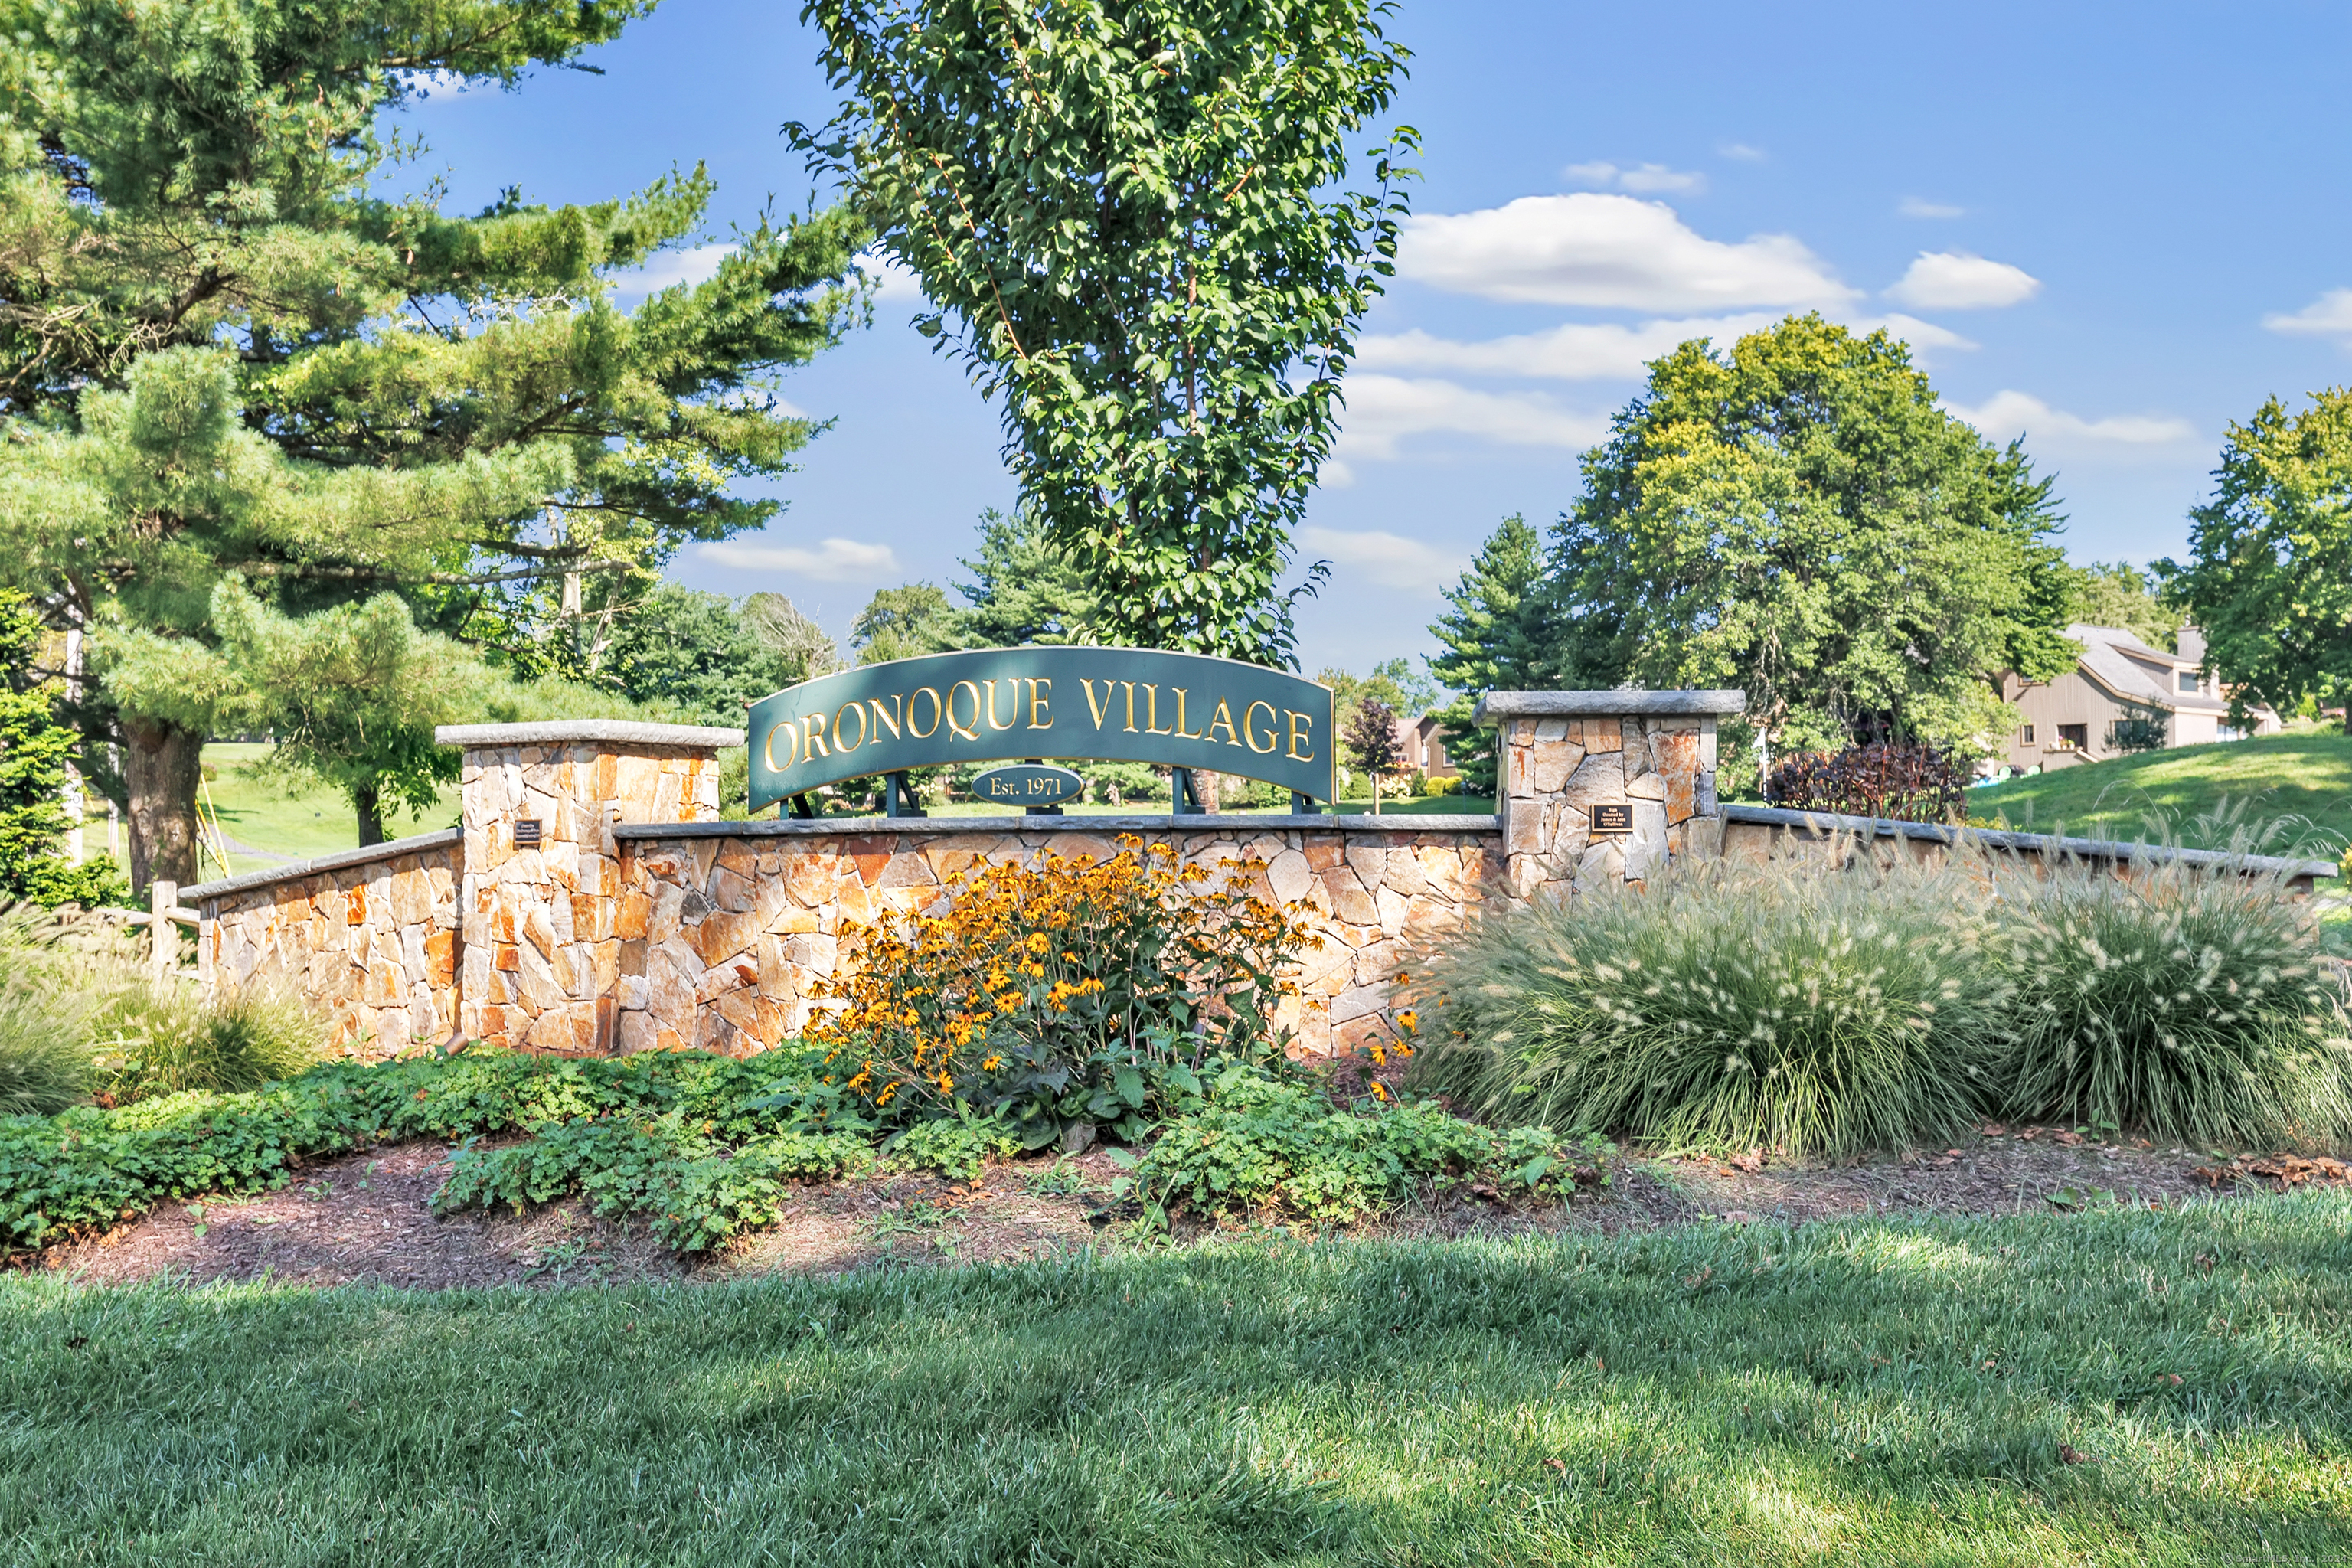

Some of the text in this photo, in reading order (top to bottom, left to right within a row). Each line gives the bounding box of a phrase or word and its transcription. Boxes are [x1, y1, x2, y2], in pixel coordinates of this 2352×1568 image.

[764, 678, 1315, 773] ORONOQUE VILLAGE
[990, 777, 1062, 795] Est. 1971
